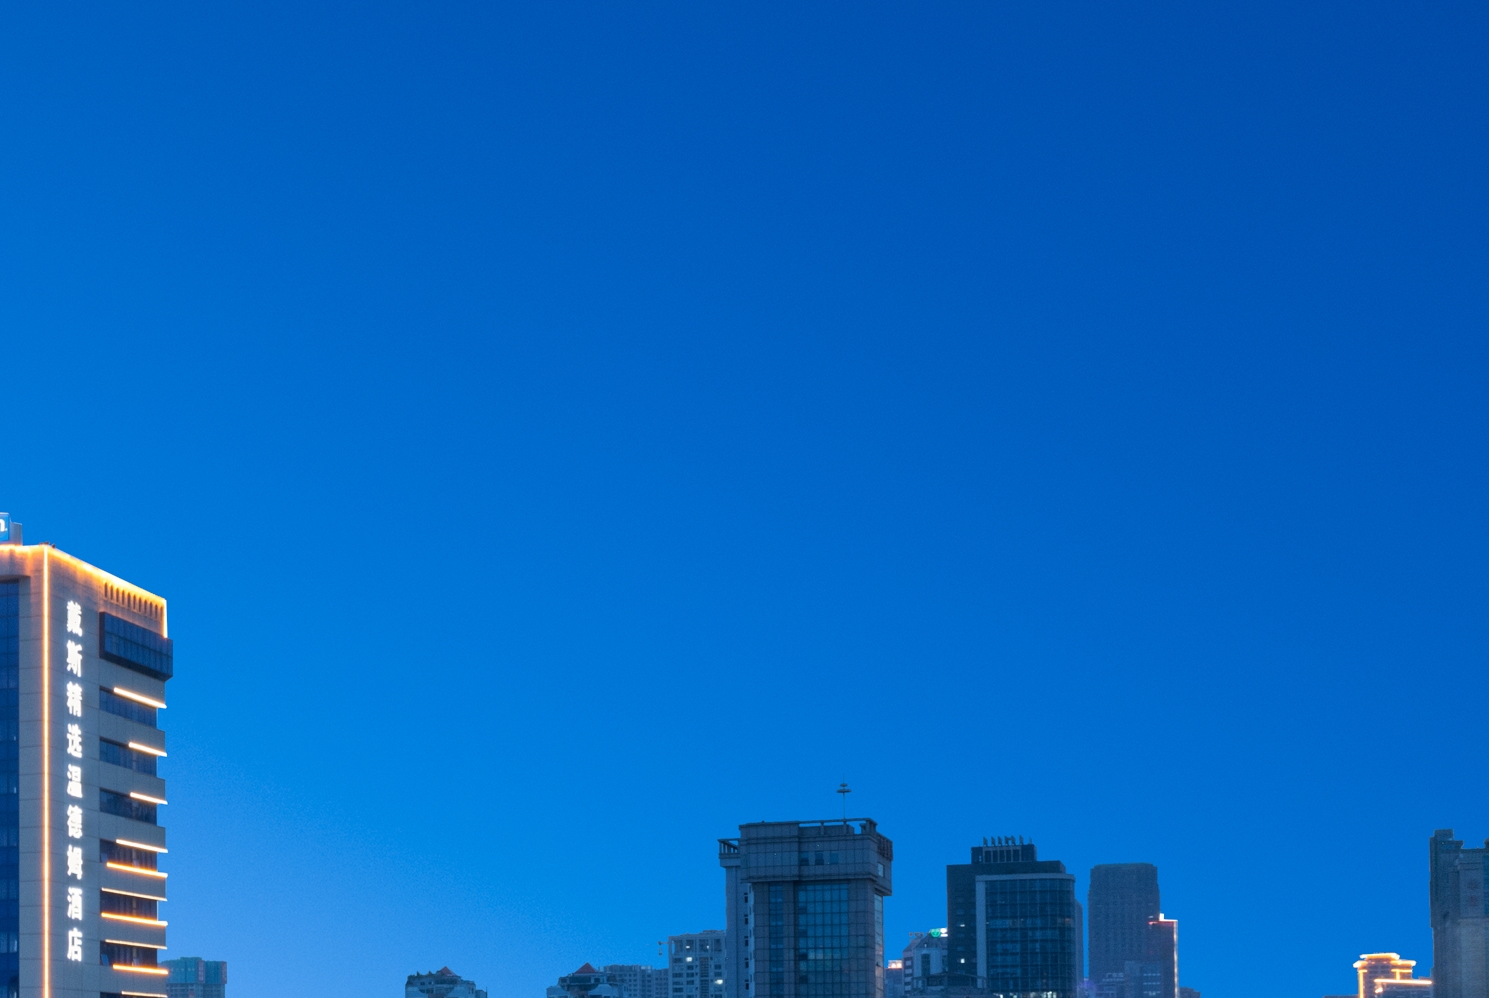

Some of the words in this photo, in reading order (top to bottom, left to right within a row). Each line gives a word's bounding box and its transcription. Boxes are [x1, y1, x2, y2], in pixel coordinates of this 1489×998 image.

[66, 600, 83, 962] 戴斯精选温德姆酒店
